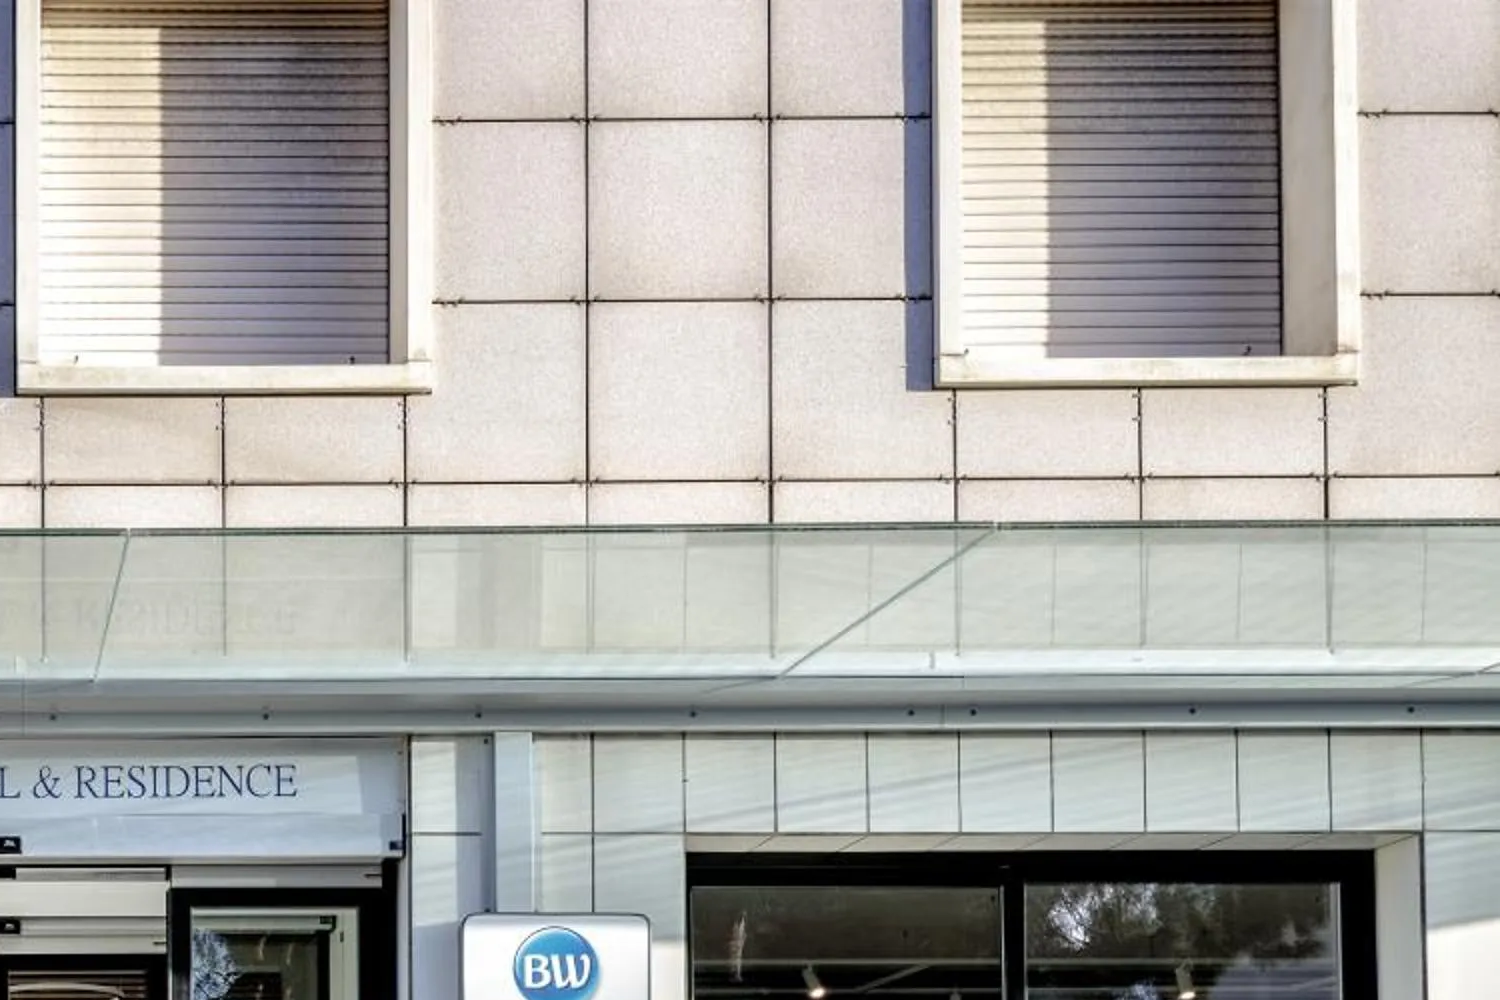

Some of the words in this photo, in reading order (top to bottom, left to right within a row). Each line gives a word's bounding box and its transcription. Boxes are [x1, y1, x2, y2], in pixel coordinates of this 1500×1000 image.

[32, 765, 61, 799] &
[74, 764, 299, 799] RESIDENCE
[523, 953, 592, 989] BW
